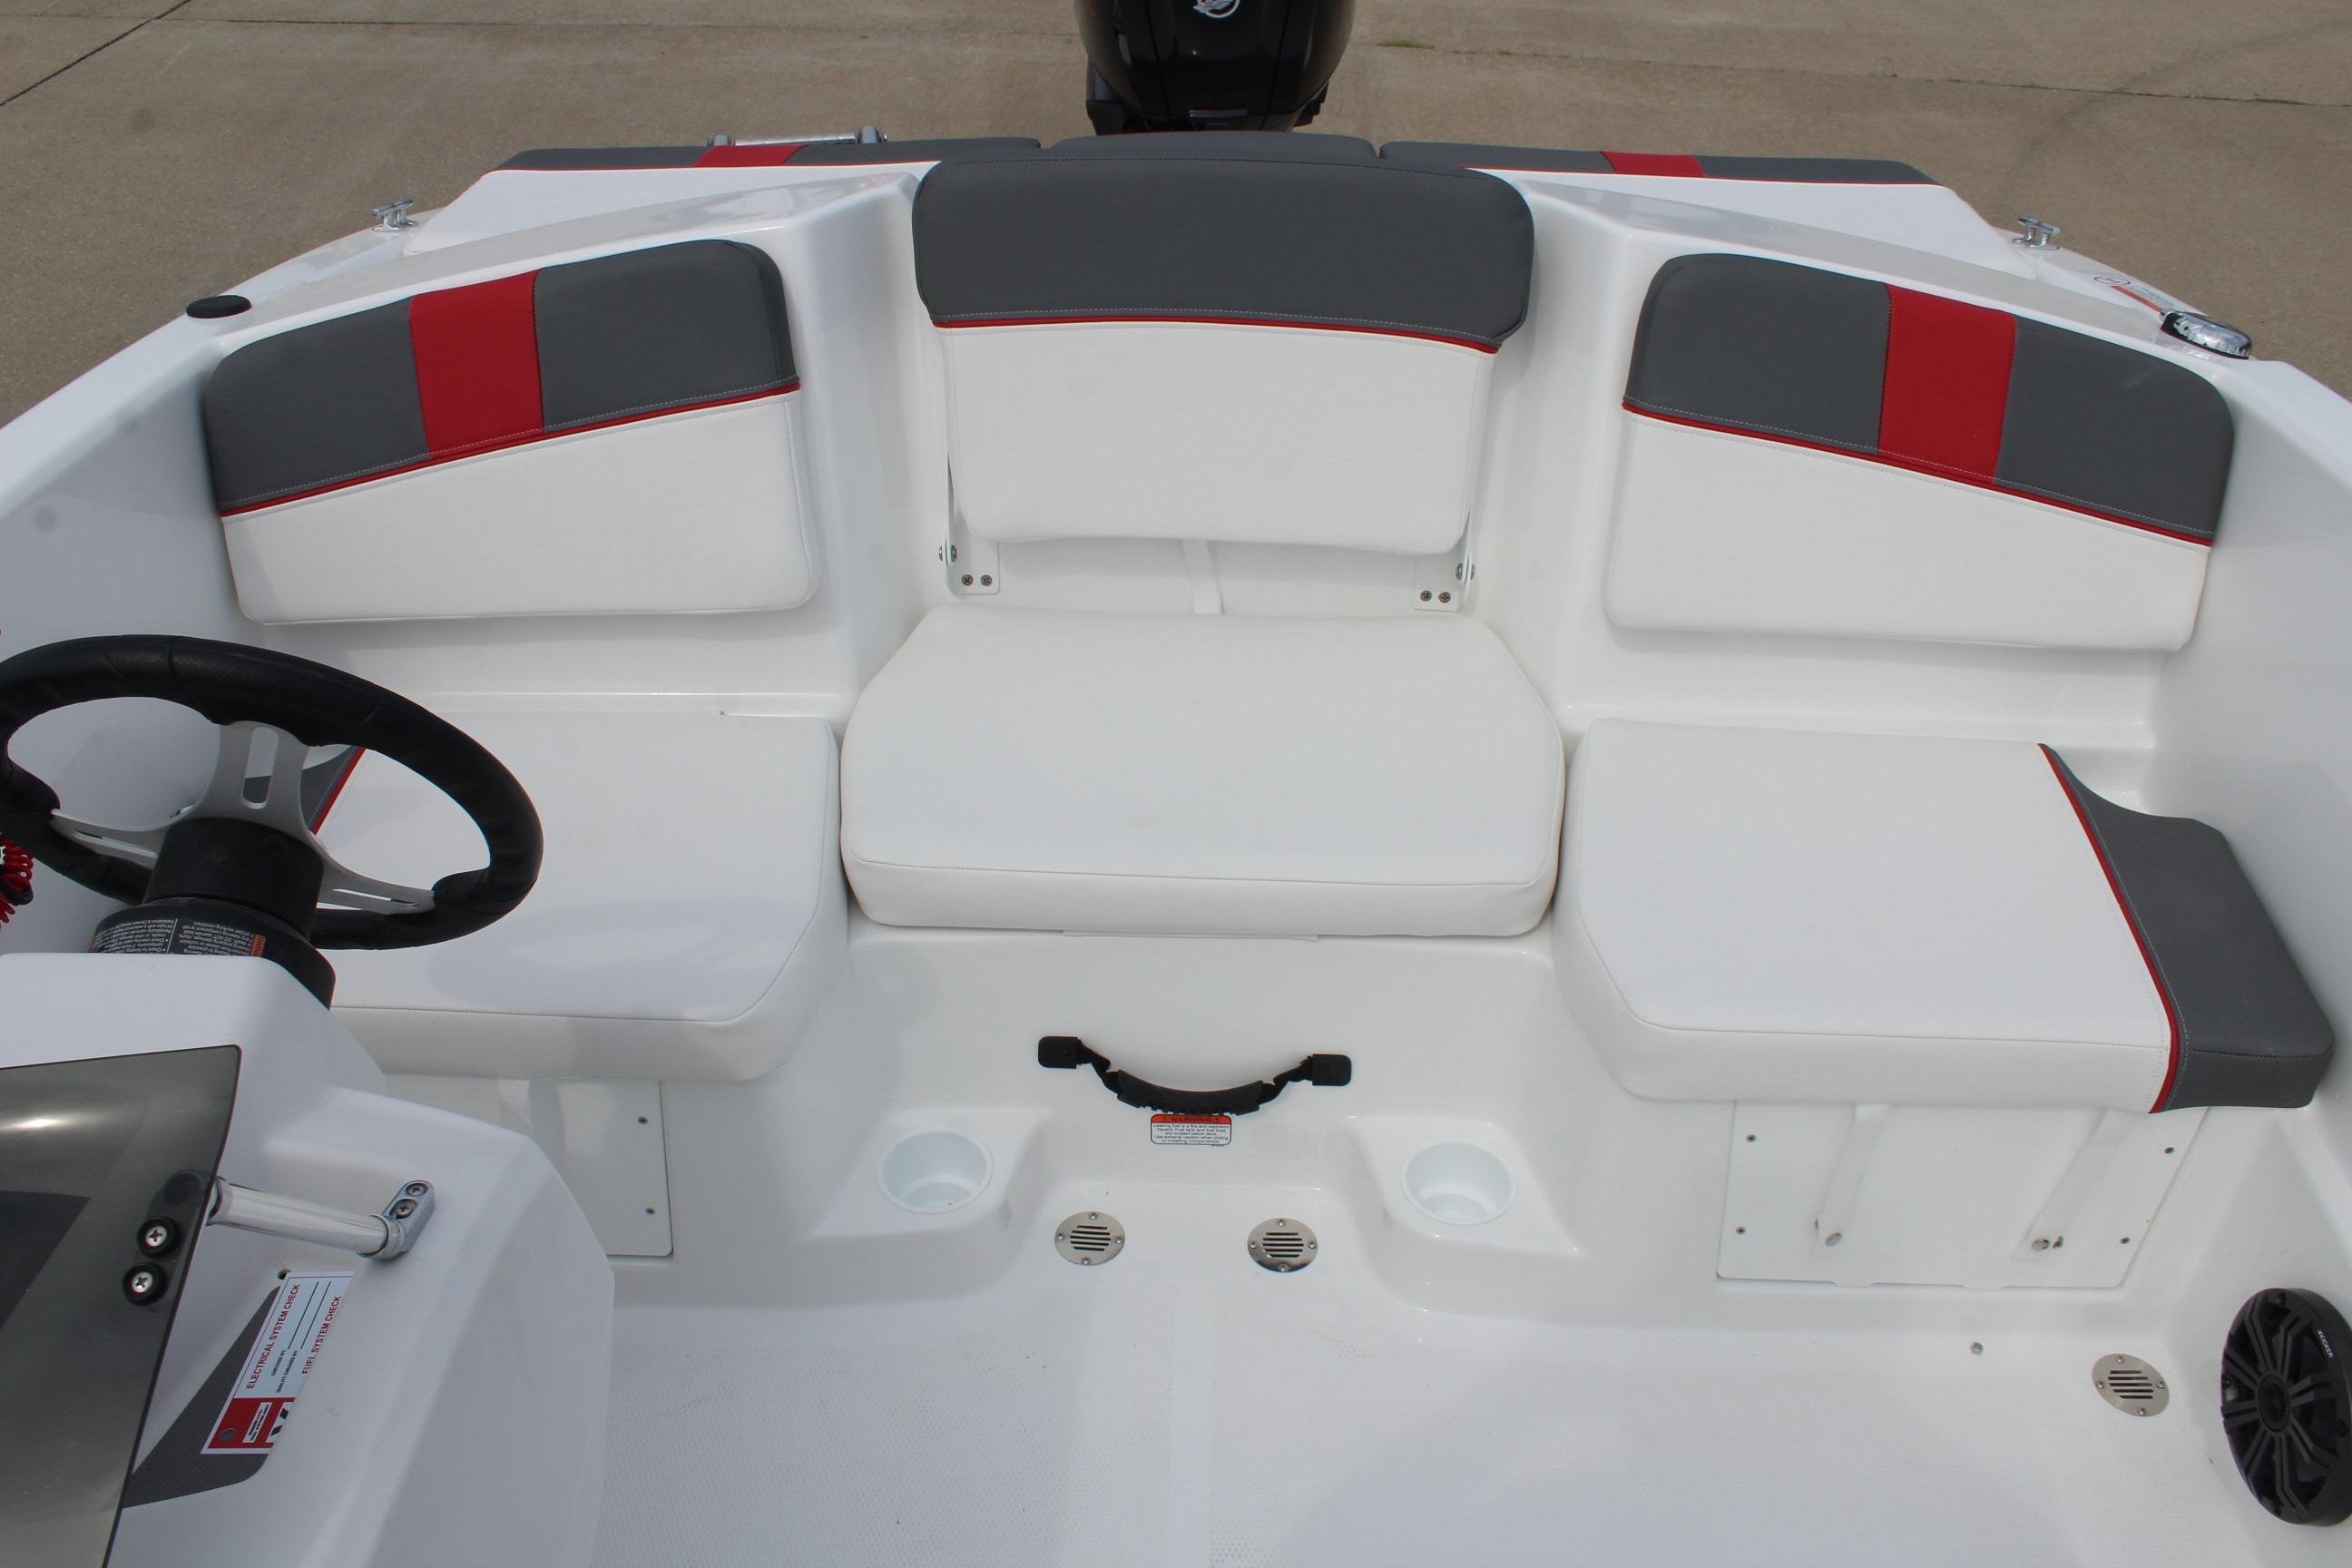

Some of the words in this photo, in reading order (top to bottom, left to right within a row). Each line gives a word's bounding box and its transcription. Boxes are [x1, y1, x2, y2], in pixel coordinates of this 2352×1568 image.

[246, 1341, 276, 1389] ELECTRICAL
[269, 1310, 290, 1341] SYSTEM
[283, 1284, 301, 1309] CHECK
[310, 1322, 331, 1353] SYSTEM
[325, 1296, 341, 1321] CHECK
[270, 1357, 284, 1377] CHECKED
[276, 1375, 289, 1394] QUALITY
[283, 1357, 297, 1377] CHECKED
